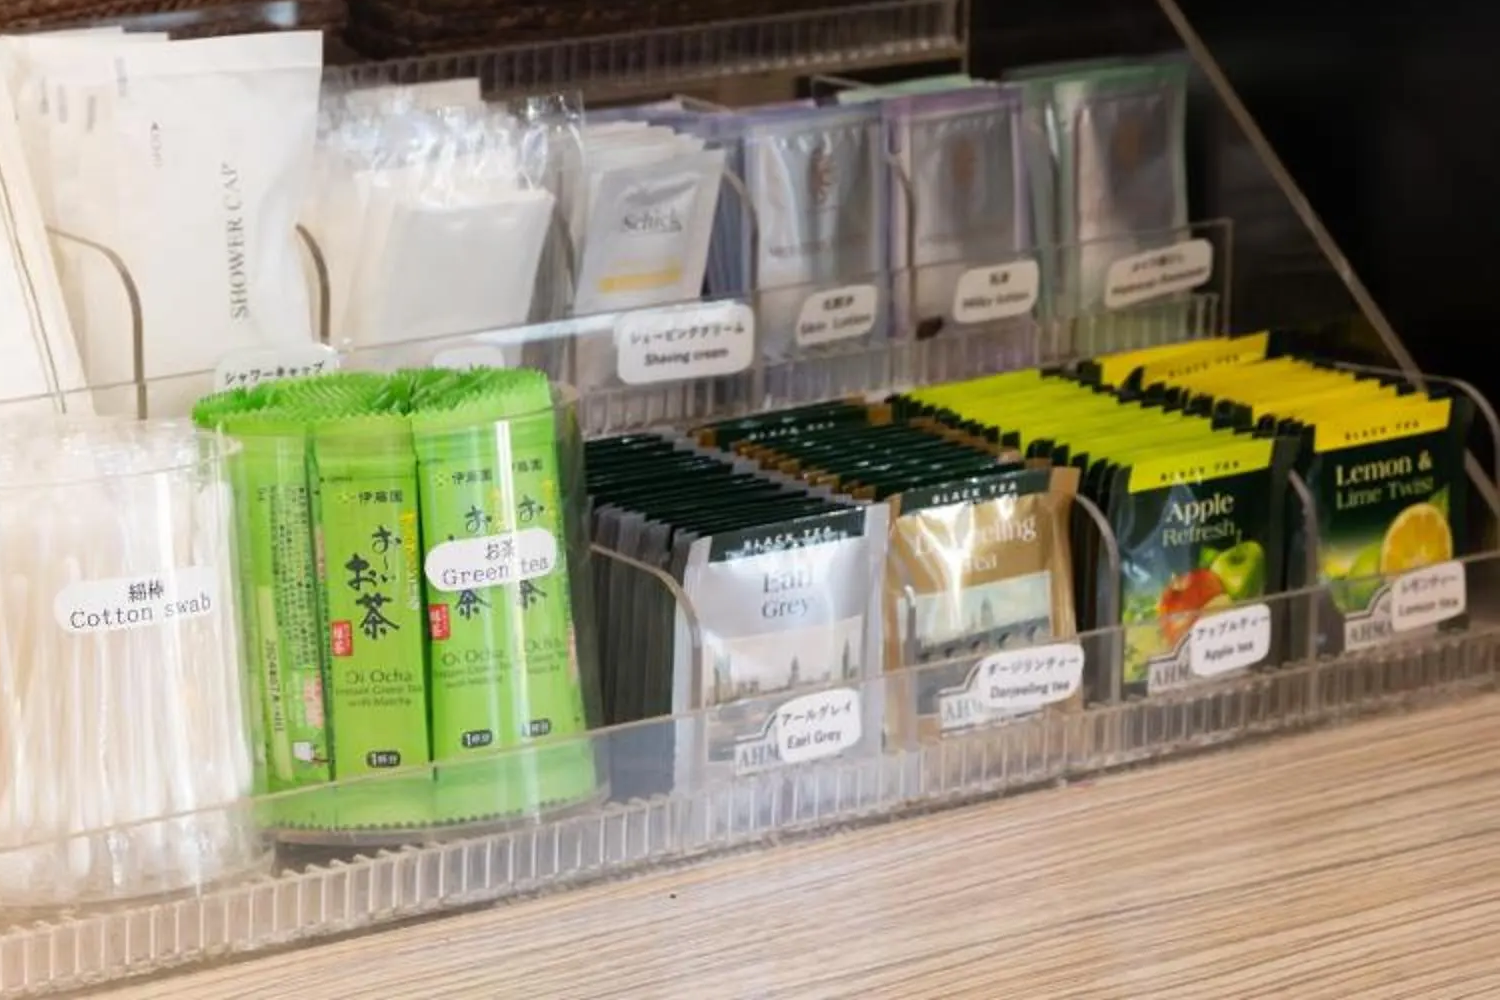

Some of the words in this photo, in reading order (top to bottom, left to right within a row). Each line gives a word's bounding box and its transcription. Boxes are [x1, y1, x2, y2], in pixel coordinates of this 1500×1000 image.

[220, 162, 244, 212] CAP
[224, 217, 250, 320] SHOWER
[644, 352, 690, 366] Shaving
[225, 360, 325, 385] シャワーキャップ
[1335, 455, 1412, 487] Lemon
[1418, 449, 1433, 472] &
[932, 488, 981, 504] BLACK
[990, 481, 1018, 494] TEA
[1336, 487, 1383, 510] Lime
[1387, 476, 1434, 500] Twist
[1166, 492, 1235, 527] Apple
[743, 532, 794, 550] BLACK
[1162, 519, 1235, 547] Refresh
[442, 565, 510, 586] Green
[520, 557, 550, 575] tea
[70, 607, 154, 629] Cotton
[164, 592, 212, 618] swab
[762, 598, 809, 619] Grey
[1204, 645, 1235, 661] Apple
[370, 668, 413, 683] Ocha
[990, 681, 1049, 699] Darjeeling
[1052, 680, 1071, 692] tea
[781, 700, 852, 727] アールグレイ
[787, 735, 811, 749] Earl
[814, 730, 842, 745] Grey
